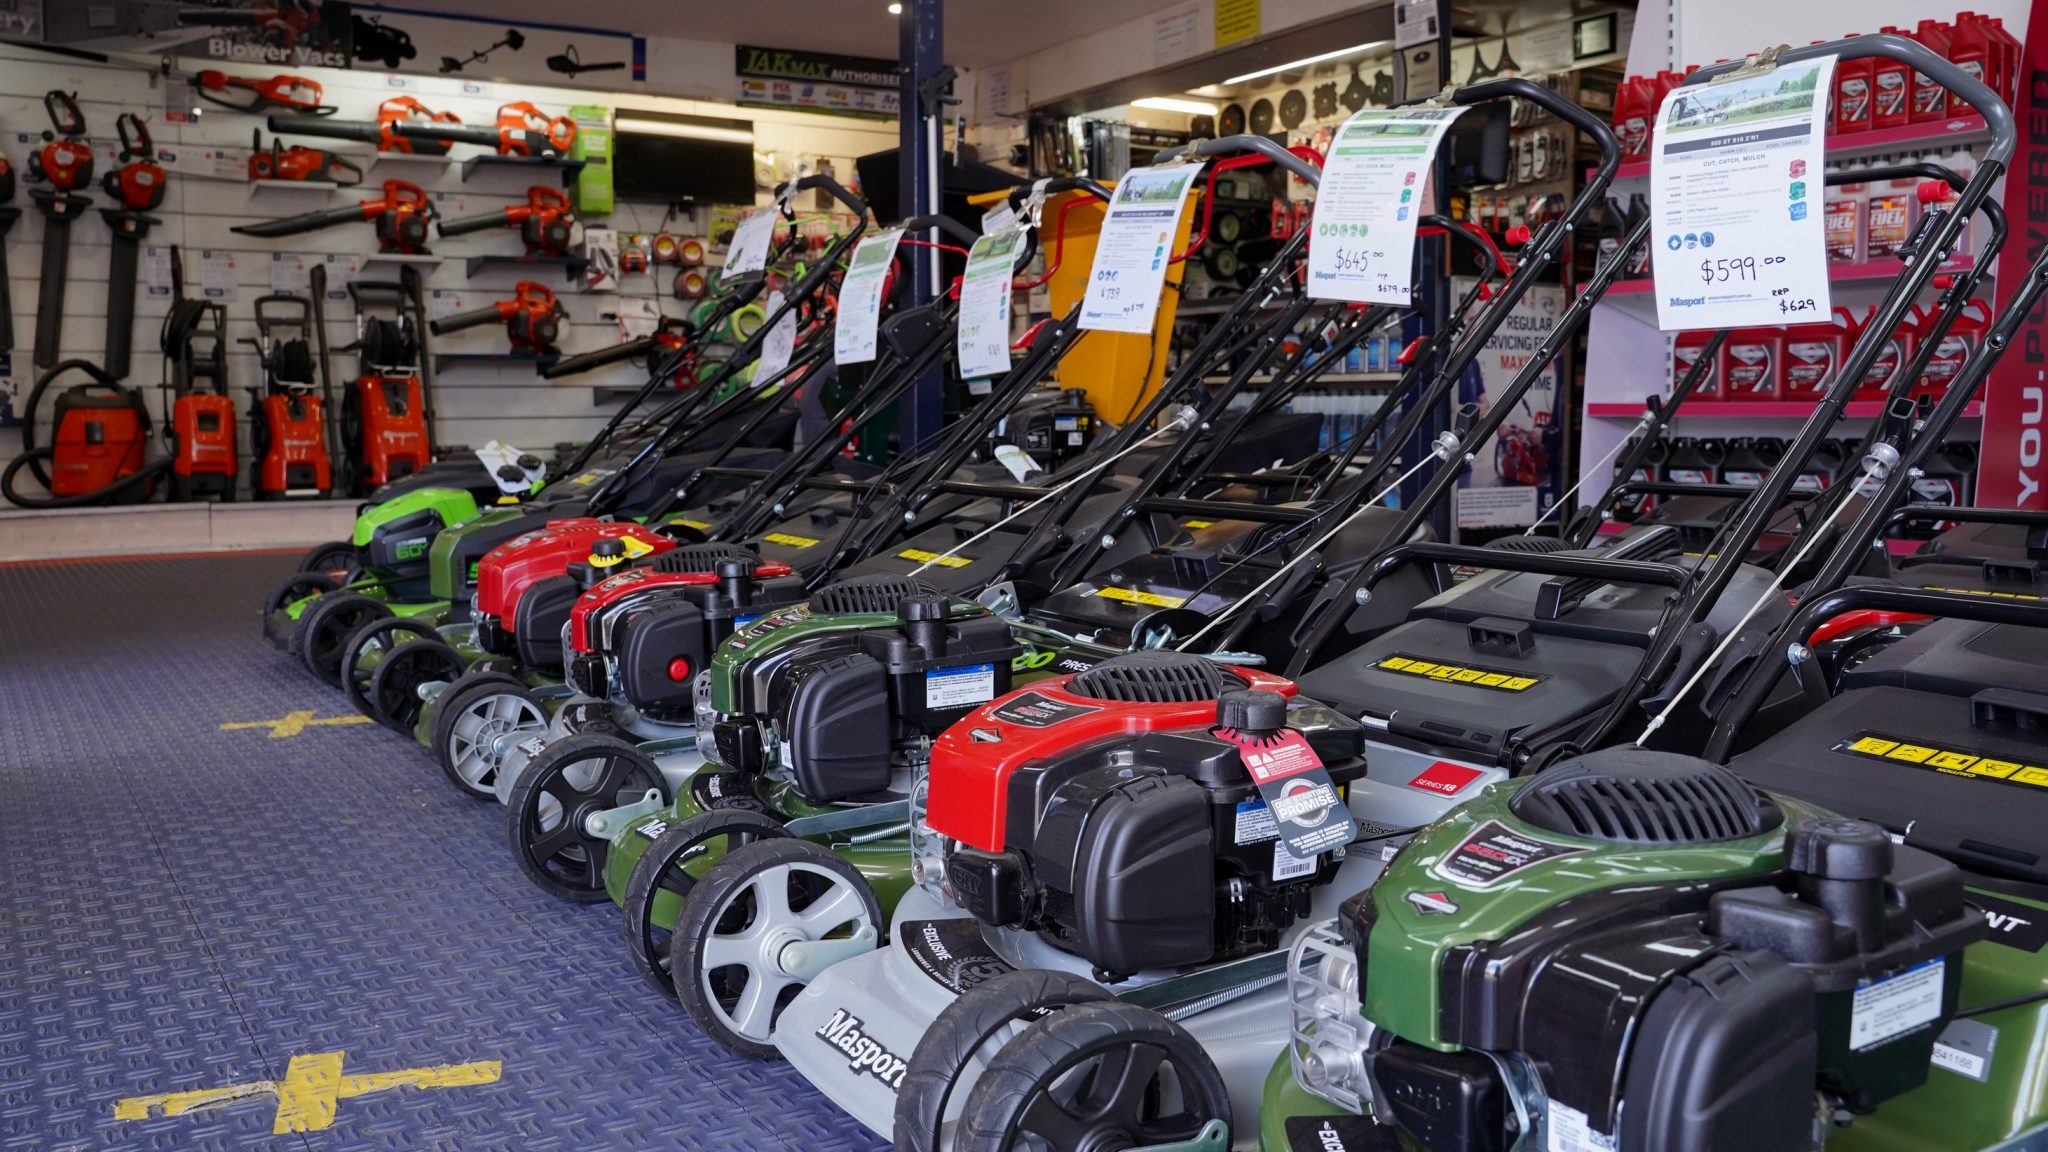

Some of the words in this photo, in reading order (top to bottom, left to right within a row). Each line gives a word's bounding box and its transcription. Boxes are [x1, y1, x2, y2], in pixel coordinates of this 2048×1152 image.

[208, 38, 291, 62] Blower
[295, 46, 346, 67] Vacs
[831, 69, 900, 86] AUTHORISE
[1743, 154, 1766, 162] MULCH
[1870, 211, 1904, 226] FUEL
[1772, 287, 1790, 297] RRP
[1670, 296, 1706, 307] Masport
[1779, 299, 1817, 315] $629
[1507, 315, 1552, 331] REGULAR
[1484, 335, 1532, 350] ERVICING
[2017, 370, 2044, 507] YOU.
[1277, 792, 1336, 820] PROMISE
